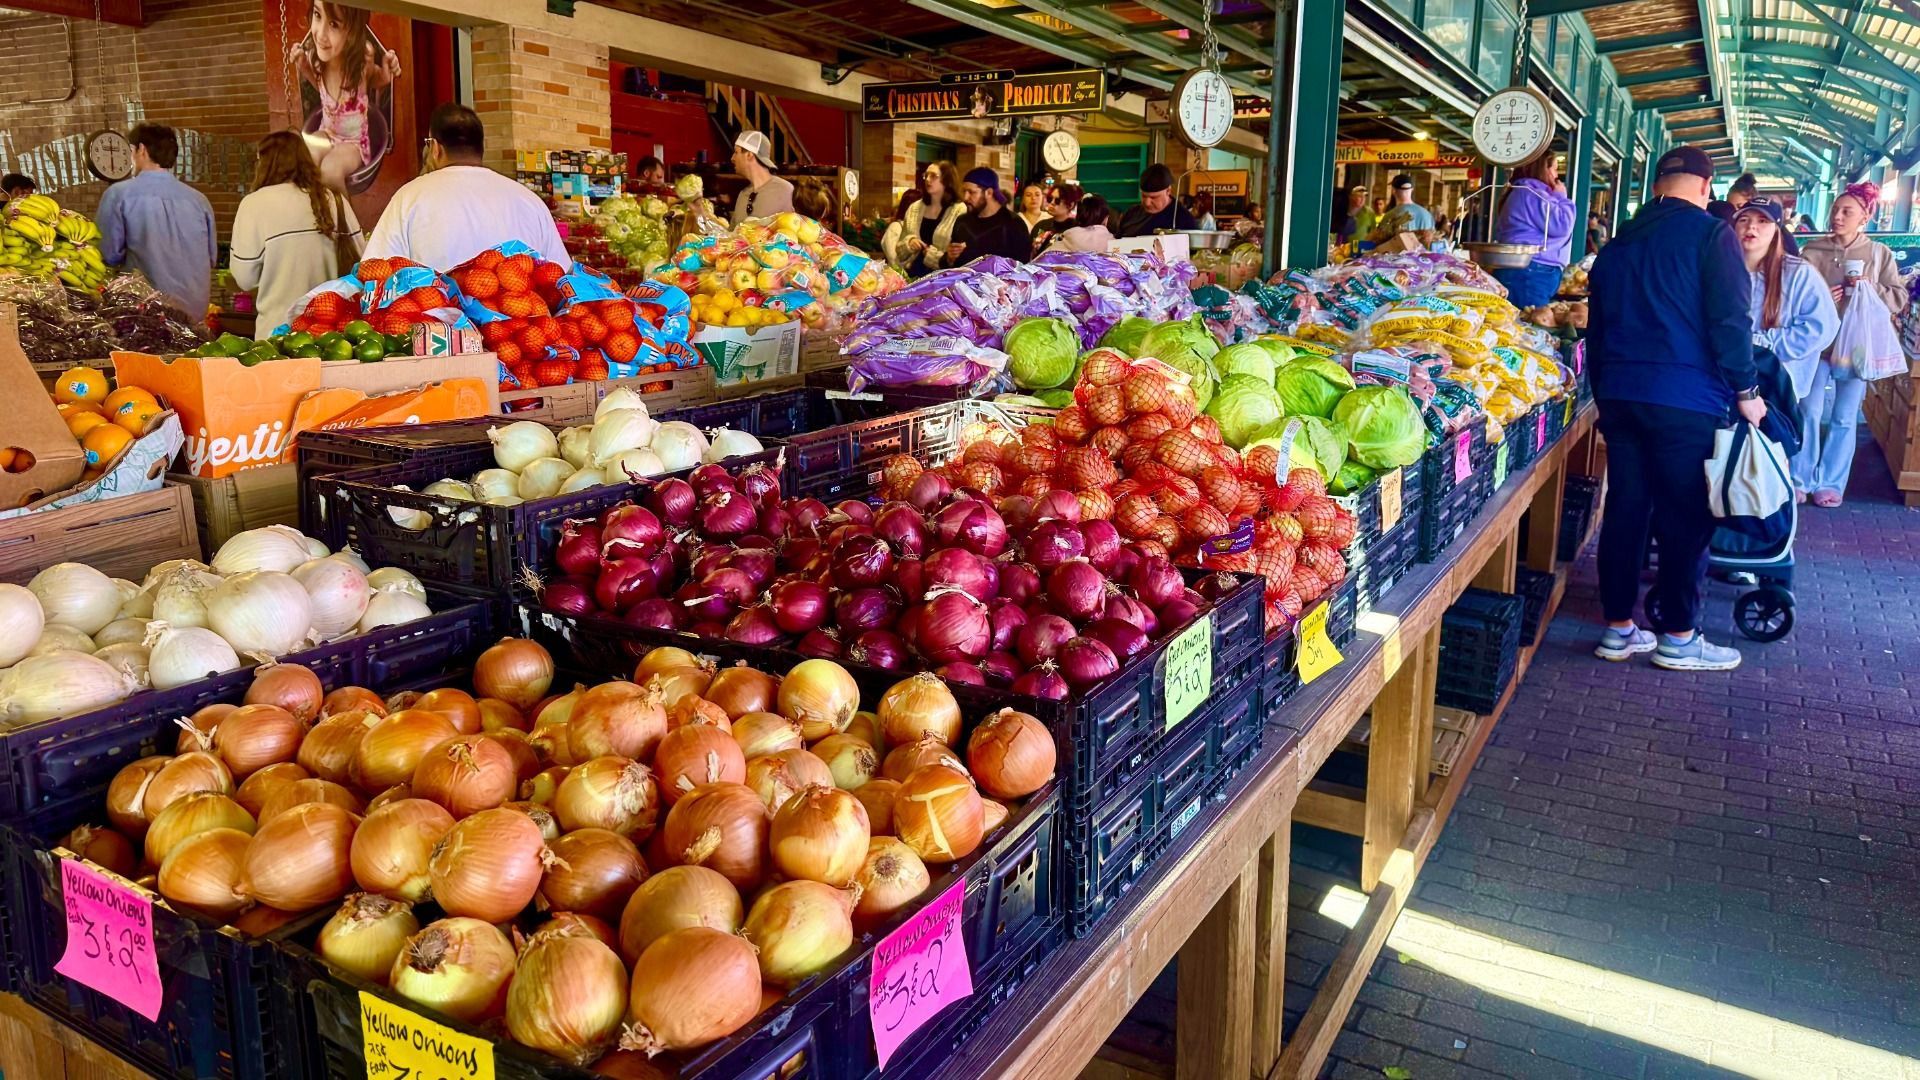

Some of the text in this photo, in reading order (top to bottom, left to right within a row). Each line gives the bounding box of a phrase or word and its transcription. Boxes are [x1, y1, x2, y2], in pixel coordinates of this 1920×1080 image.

[955, 72, 999, 81] 3-13-01
[888, 83, 1072, 119] CRISTINA'S PRODUCE
[1494, 104, 1502, 113] 9
[1525, 103, 1529, 111] 1
[1484, 116, 1491, 125] 8
[1532, 114, 1540, 124] 2
[1483, 131, 1490, 141] 7
[1531, 130, 1538, 139] 3
[1491, 144, 1498, 153] 6
[1520, 142, 1527, 150] 4
[1336, 147, 1363, 161] NFLY
[1505, 147, 1512, 157] 5
[1197, 184, 1238, 193] SPECIALS
[65, 865, 147, 927] Yellow Onions
[80, 914, 101, 959] 3
[886, 971, 910, 1032] 3
[919, 938, 943, 998] 2
[363, 1004, 409, 1041] Yellow
[412, 1029, 478, 1076] Onions
